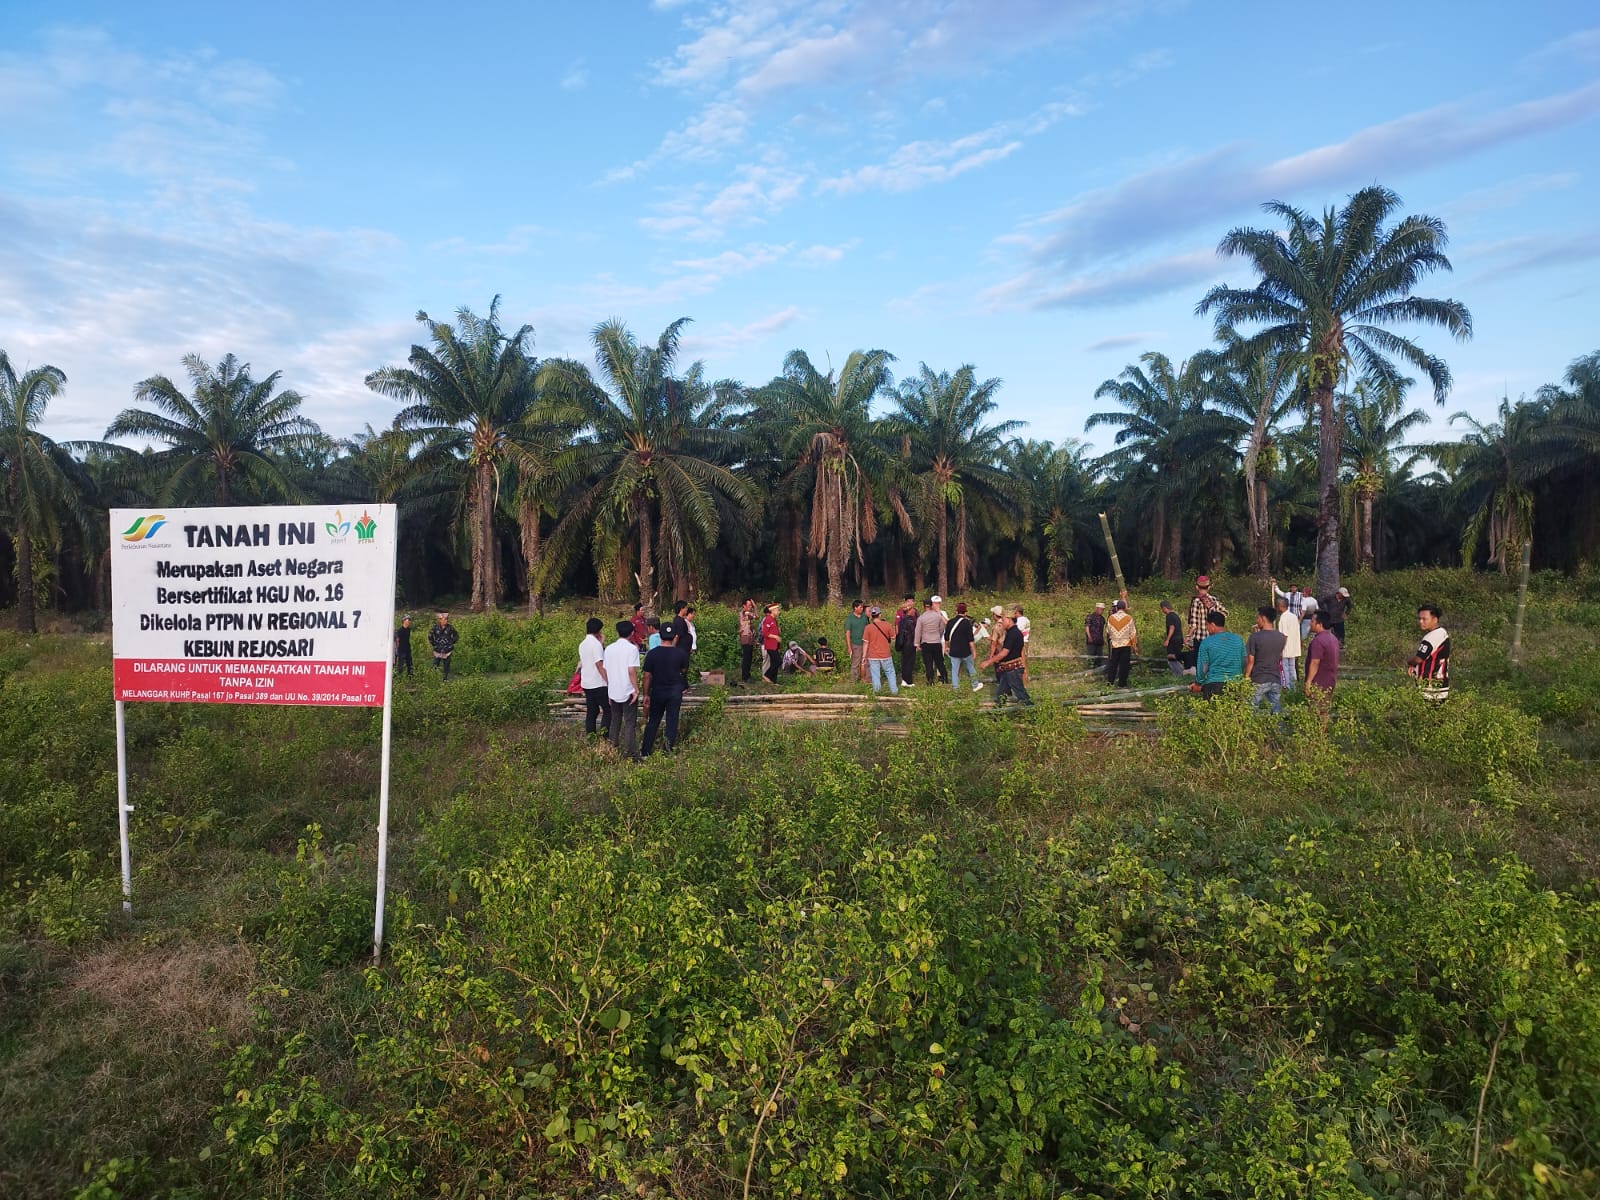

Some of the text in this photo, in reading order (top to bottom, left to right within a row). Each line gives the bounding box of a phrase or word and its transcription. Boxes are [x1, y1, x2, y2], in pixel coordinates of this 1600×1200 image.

[184, 521, 316, 547] TANAH INI
[156, 558, 344, 581] Merupakan Aset Negara
[157, 582, 344, 604] Bersertifikat HGU No. 16
[140, 610, 362, 631] Dikelola PTPN IV REGIONAL 7
[184, 638, 315, 658] KEBUN REJOSARI
[133, 662, 366, 676] DILARANG UNTUK MEMANFAATKAN TANAH INI
[219, 677, 275, 688] TANPA IZIN
[122, 690, 169, 699] MELANGGAR
[191, 691, 211, 701] Pasal
[212, 692, 225, 701] 167
[226, 692, 234, 703] jo
[234, 692, 254, 702] Pasal
[255, 692, 269, 701] 389
[269, 692, 284, 701] dan
[285, 692, 296, 702] UU
[297, 693, 310, 702] No.
[311, 693, 341, 702] 39/2014
[341, 693, 362, 703] Pasal
[364, 694, 377, 703] 107
